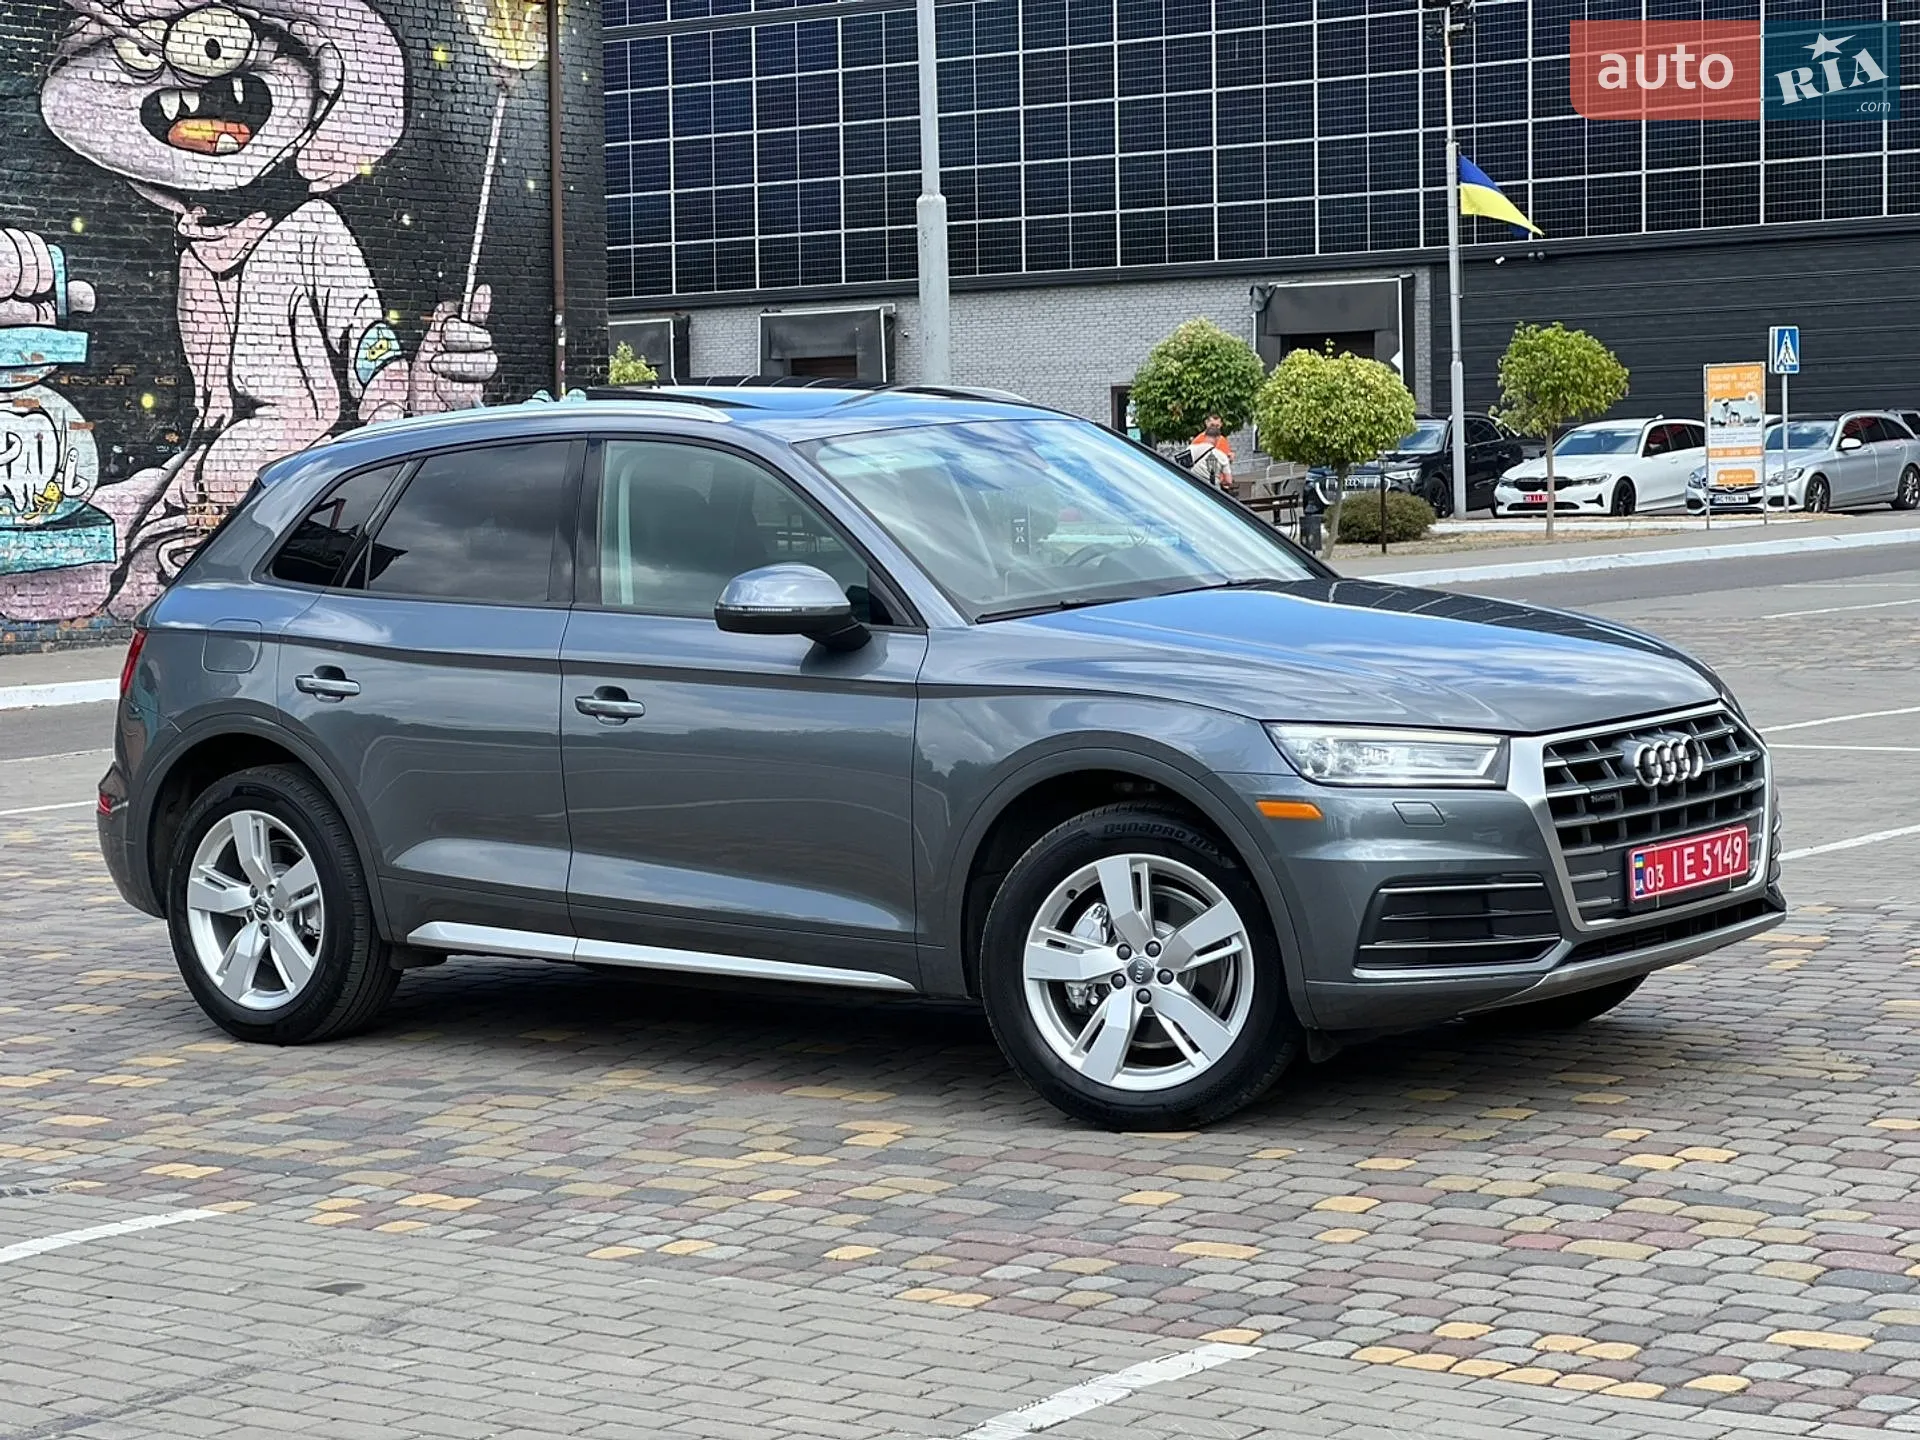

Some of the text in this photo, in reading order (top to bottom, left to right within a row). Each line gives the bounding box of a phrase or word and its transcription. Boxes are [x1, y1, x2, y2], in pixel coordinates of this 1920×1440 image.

[1646, 835, 1743, 890] 03 IE 5149
